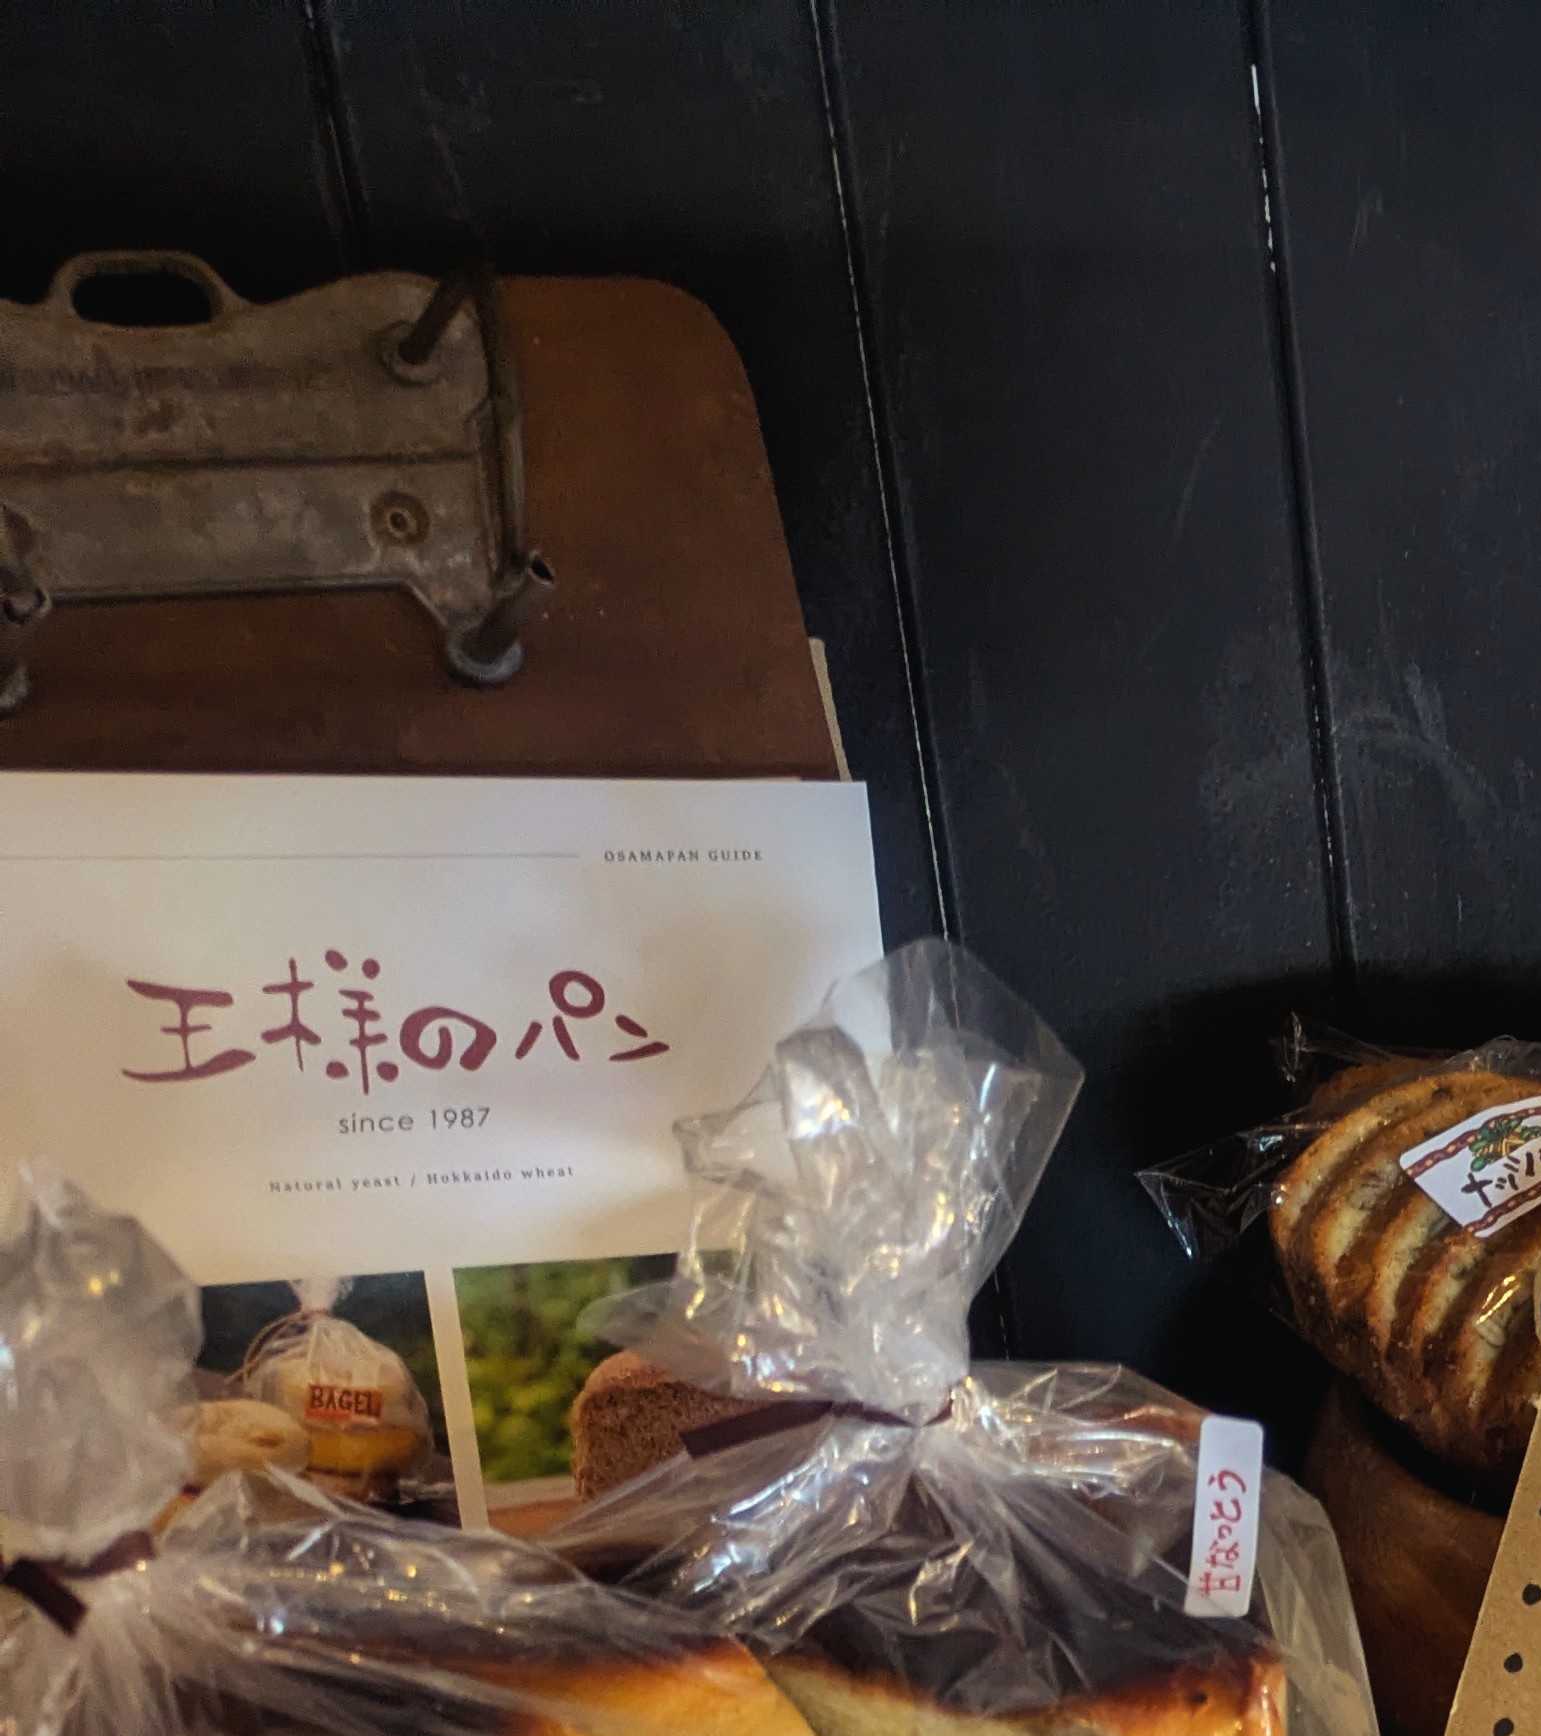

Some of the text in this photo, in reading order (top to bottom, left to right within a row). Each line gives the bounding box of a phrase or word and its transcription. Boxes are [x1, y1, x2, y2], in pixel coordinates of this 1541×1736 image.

[604, 848, 763, 863] OSAMAPAN GUIDE
[121, 949, 671, 1096] 王様のパン
[337, 1107, 491, 1135] since 1987
[268, 1177, 342, 1193] Natural
[351, 1176, 400, 1191] yeast
[427, 1169, 513, 1186] Hokkaido
[521, 1165, 574, 1180] wheat
[310, 1384, 382, 1417] BAGEL
